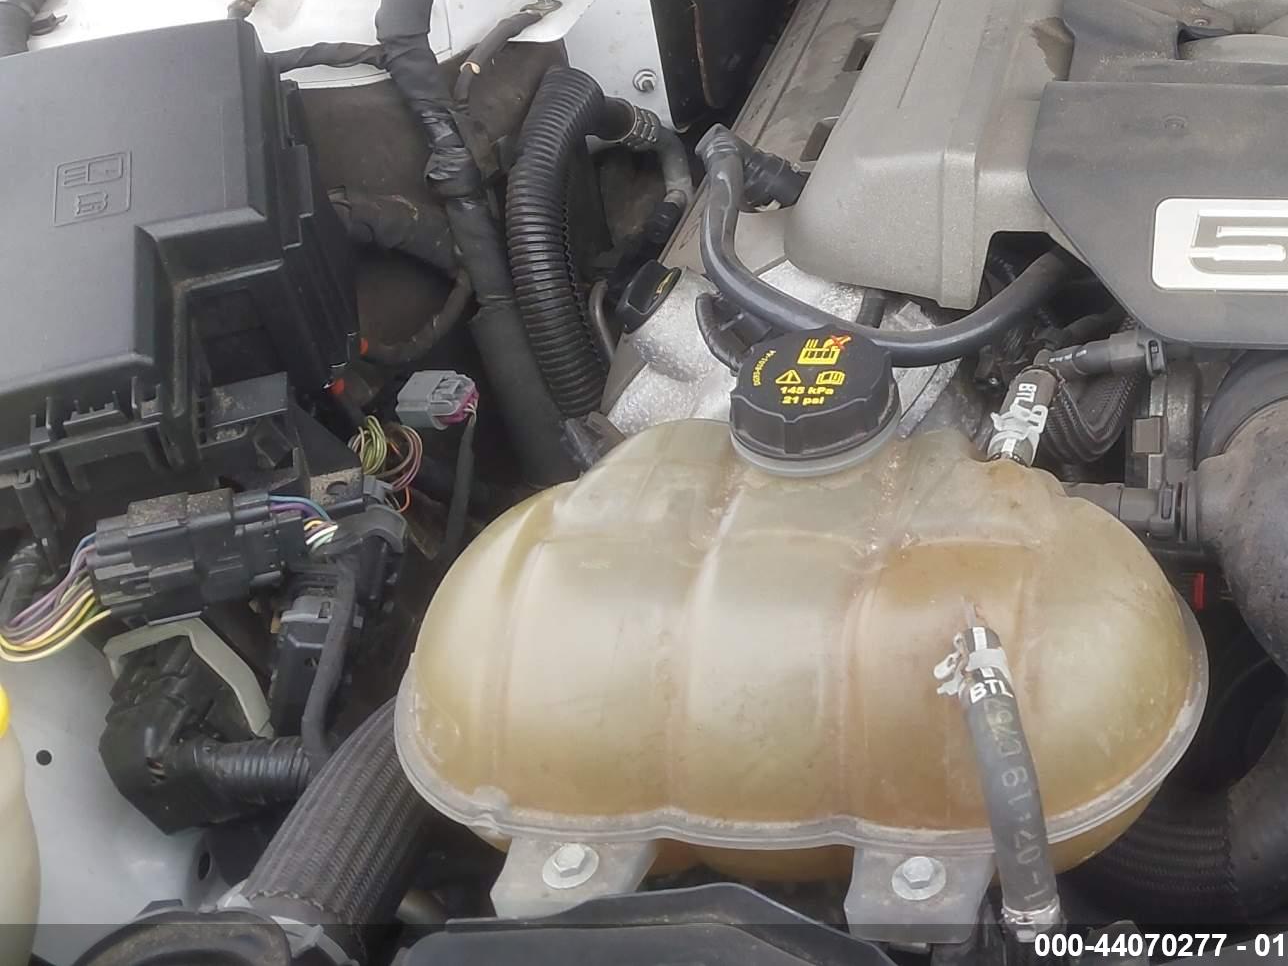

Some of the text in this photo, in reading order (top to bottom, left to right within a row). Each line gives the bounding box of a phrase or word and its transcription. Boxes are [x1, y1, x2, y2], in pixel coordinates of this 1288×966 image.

[780, 386, 834, 395] 145 kPa
[782, 395, 825, 406] 21 psi
[968, 679, 1013, 705] BTL
